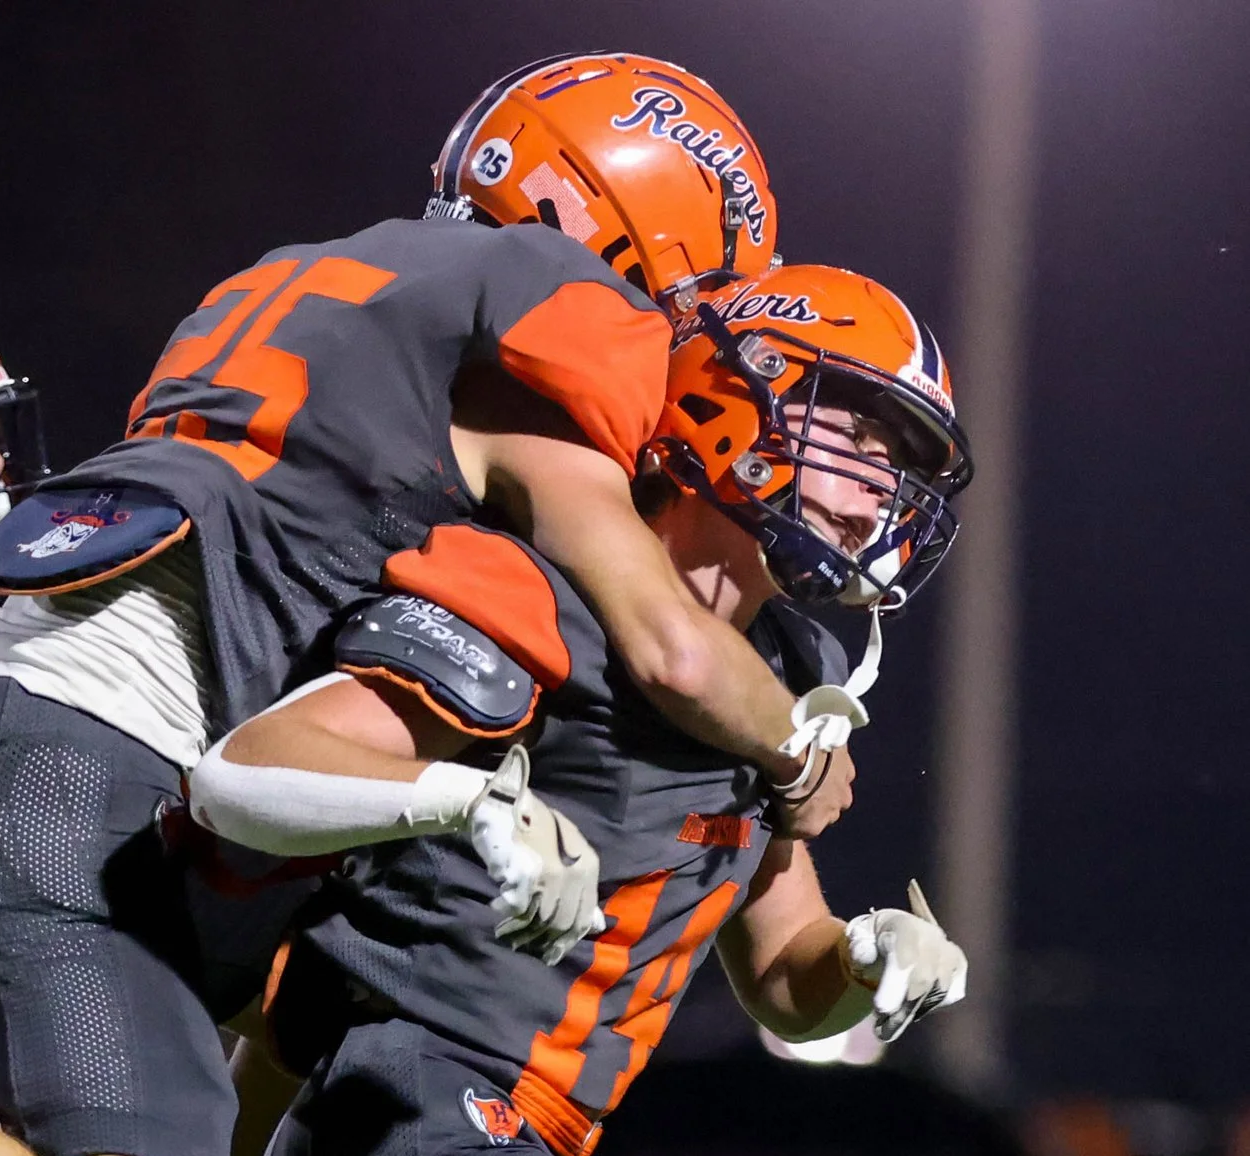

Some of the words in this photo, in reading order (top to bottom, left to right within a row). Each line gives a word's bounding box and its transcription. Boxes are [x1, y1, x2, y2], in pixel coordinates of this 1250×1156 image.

[478, 146, 508, 179] 25
[611, 87, 767, 246] Raiders
[125, 257, 399, 482] 25
[490, 1103, 509, 1124] H
